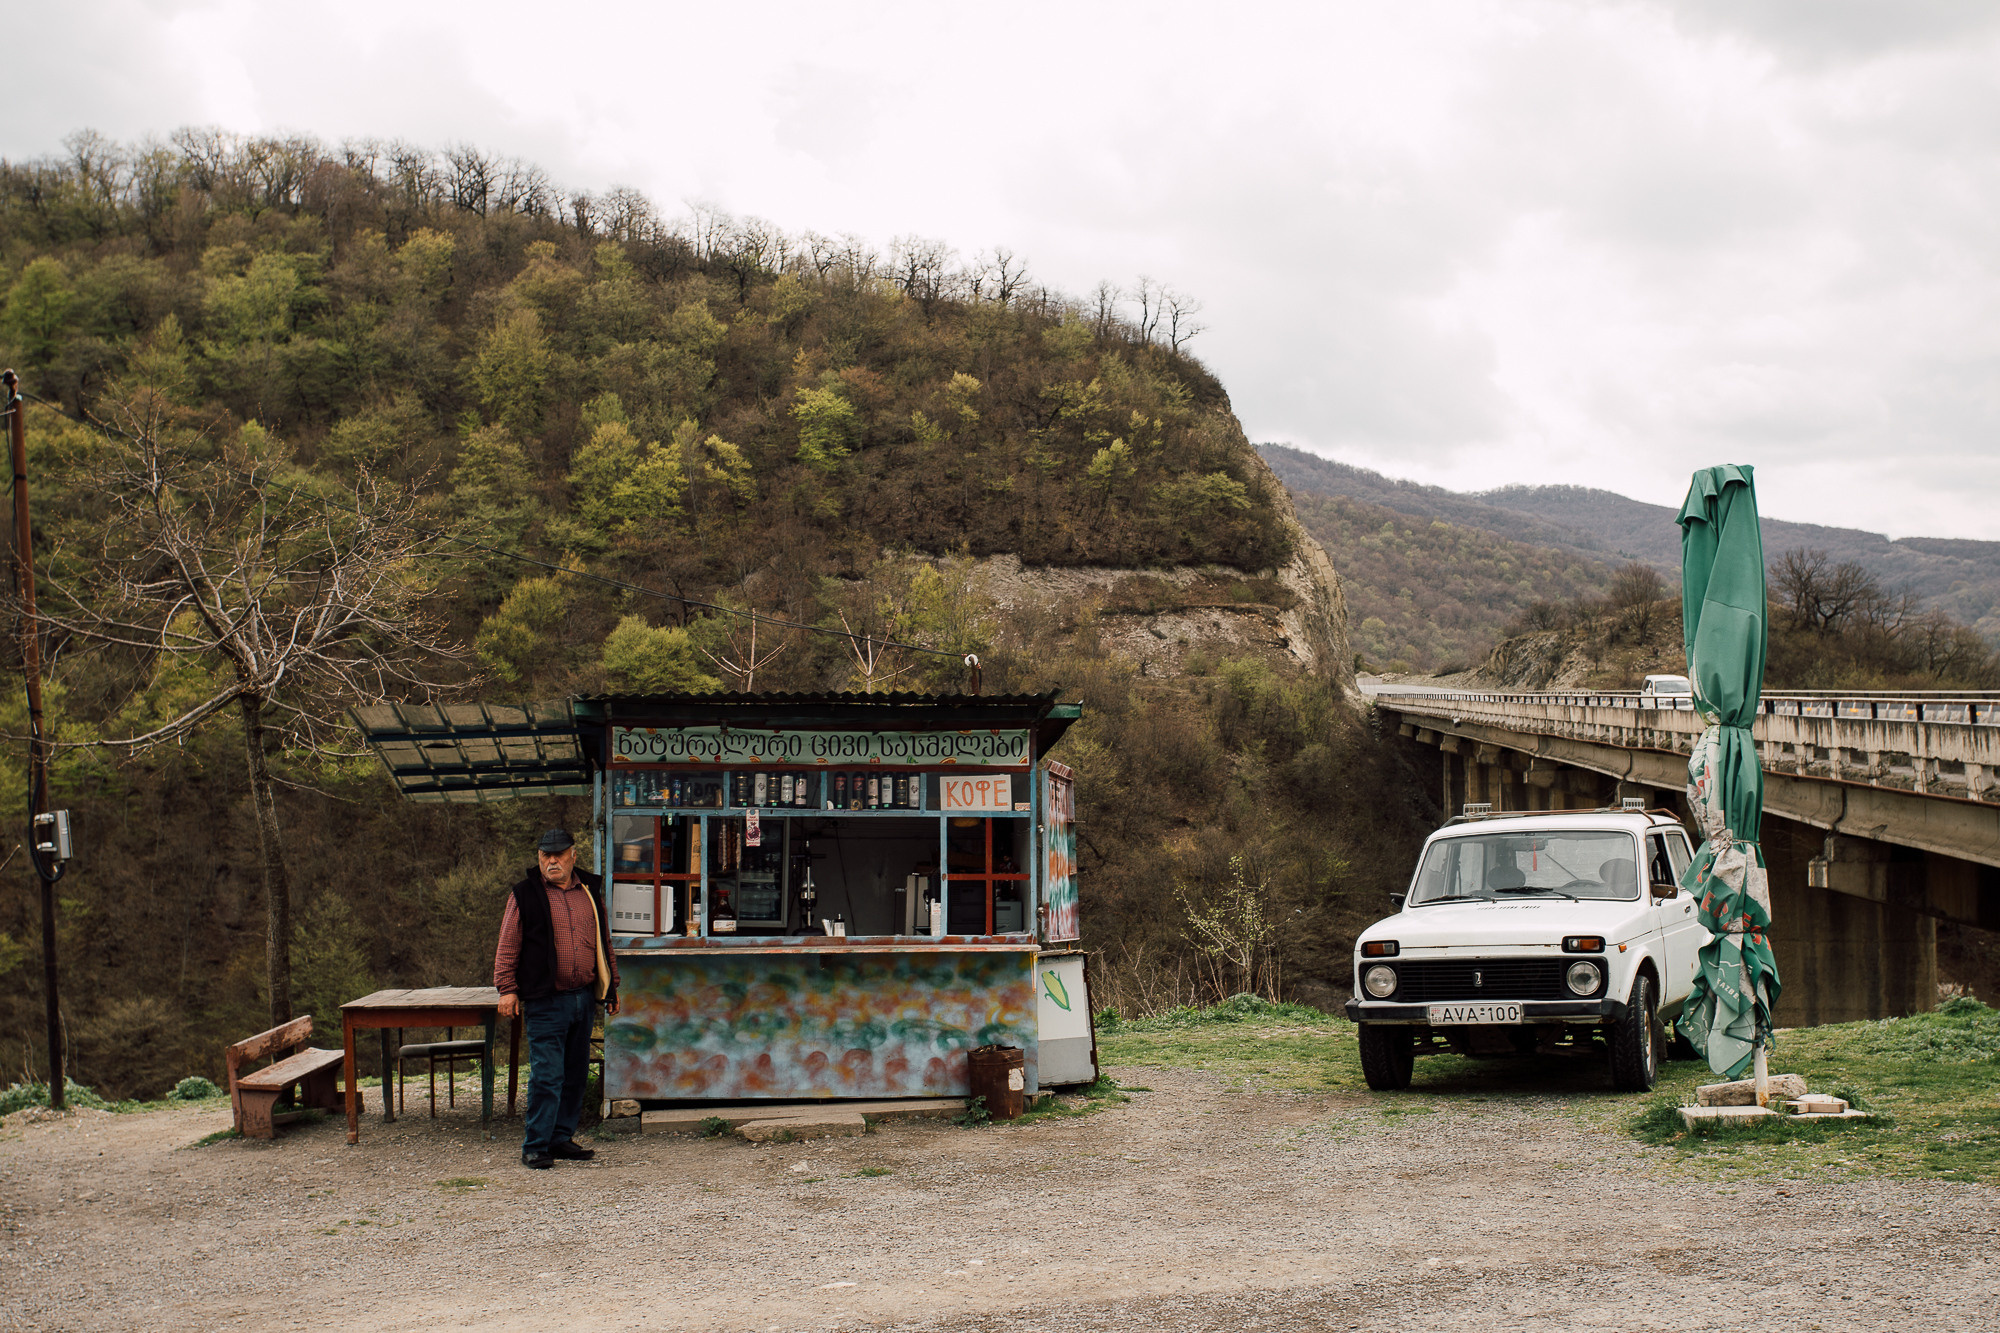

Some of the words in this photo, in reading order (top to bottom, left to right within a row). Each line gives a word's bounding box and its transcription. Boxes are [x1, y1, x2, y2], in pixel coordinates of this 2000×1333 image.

[618, 733, 802, 757] ნატურალური
[810, 733, 870, 757] ცივი
[877, 735, 1025, 757] სასმელები
[946, 779, 1008, 807] КОФЕ
